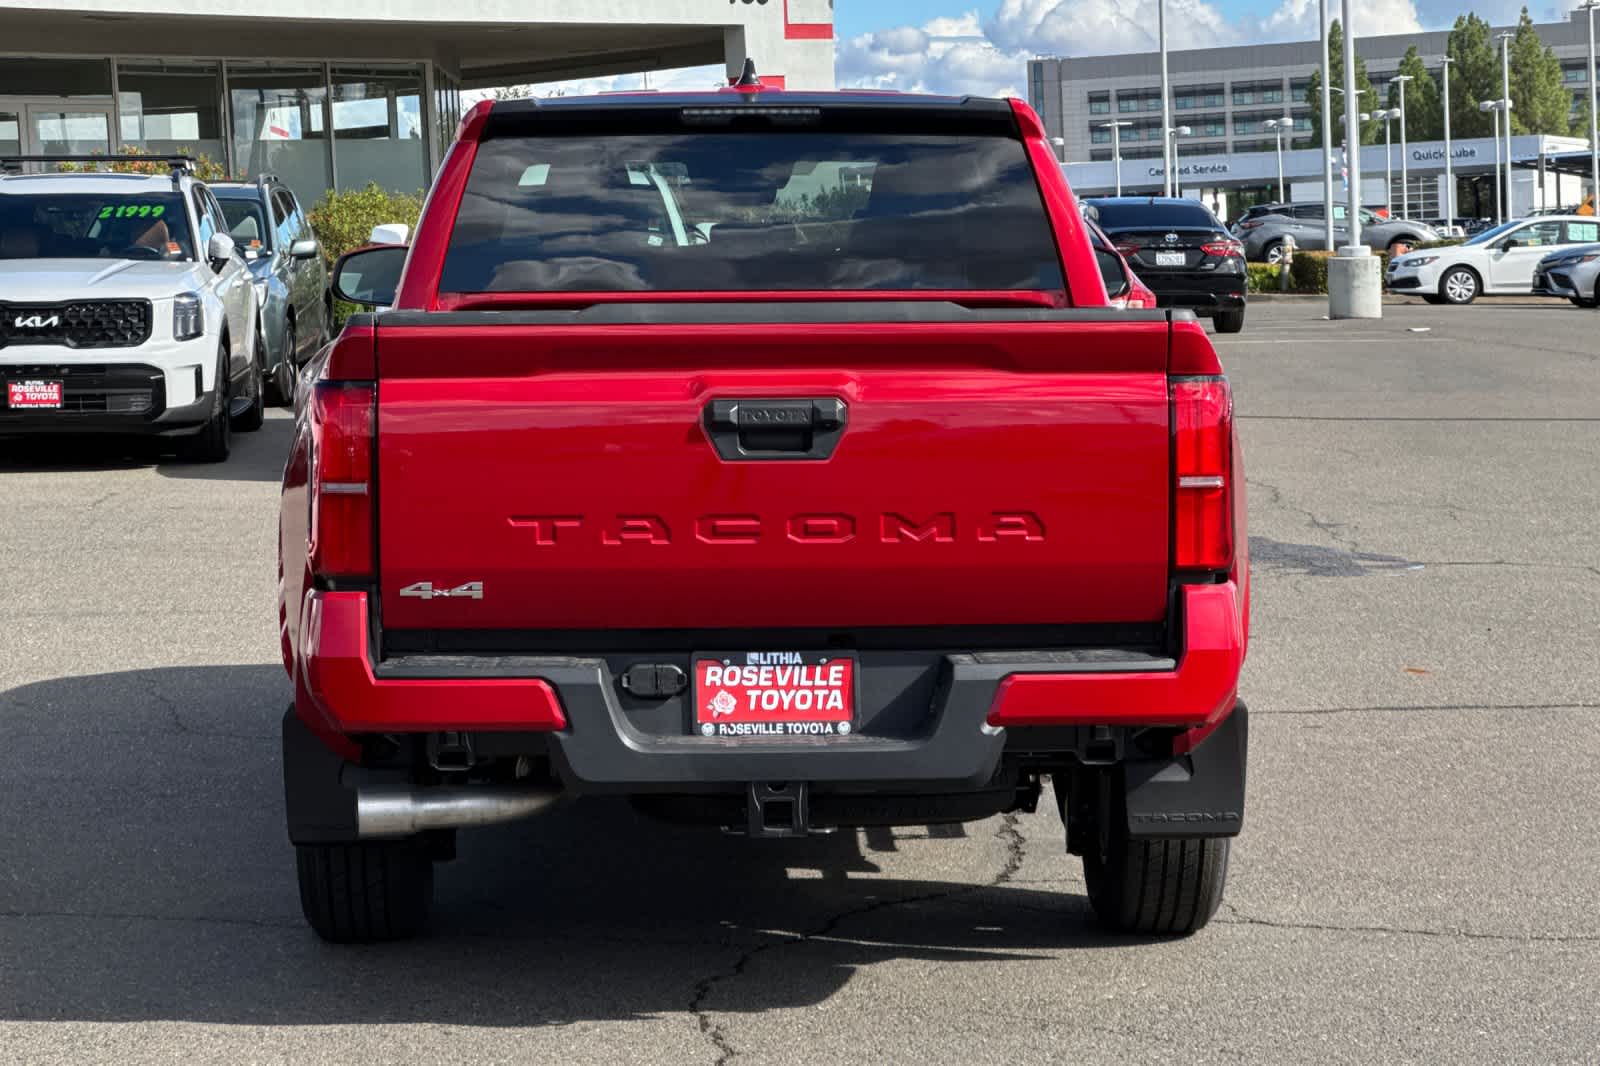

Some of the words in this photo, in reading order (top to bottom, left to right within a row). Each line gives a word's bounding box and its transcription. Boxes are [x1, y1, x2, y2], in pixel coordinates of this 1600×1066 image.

[1412, 149, 1445, 161] Quick
[1449, 147, 1476, 159] Lube
[1193, 163, 1228, 174] Service
[98, 205, 165, 218] 21999
[15, 315, 59, 327] KIA
[26, 392, 59, 400] TOYOTA
[741, 410, 810, 423] TOYOTA
[507, 511, 1047, 545] TACOMA
[399, 581, 483, 599] 4x4
[759, 652, 803, 664] LITHIA
[705, 665, 844, 686] ROSEVILLE
[746, 689, 844, 710] TOYOTA
[719, 723, 783, 735] ROSEVILLE
[1133, 812, 1240, 823] TACOMA
